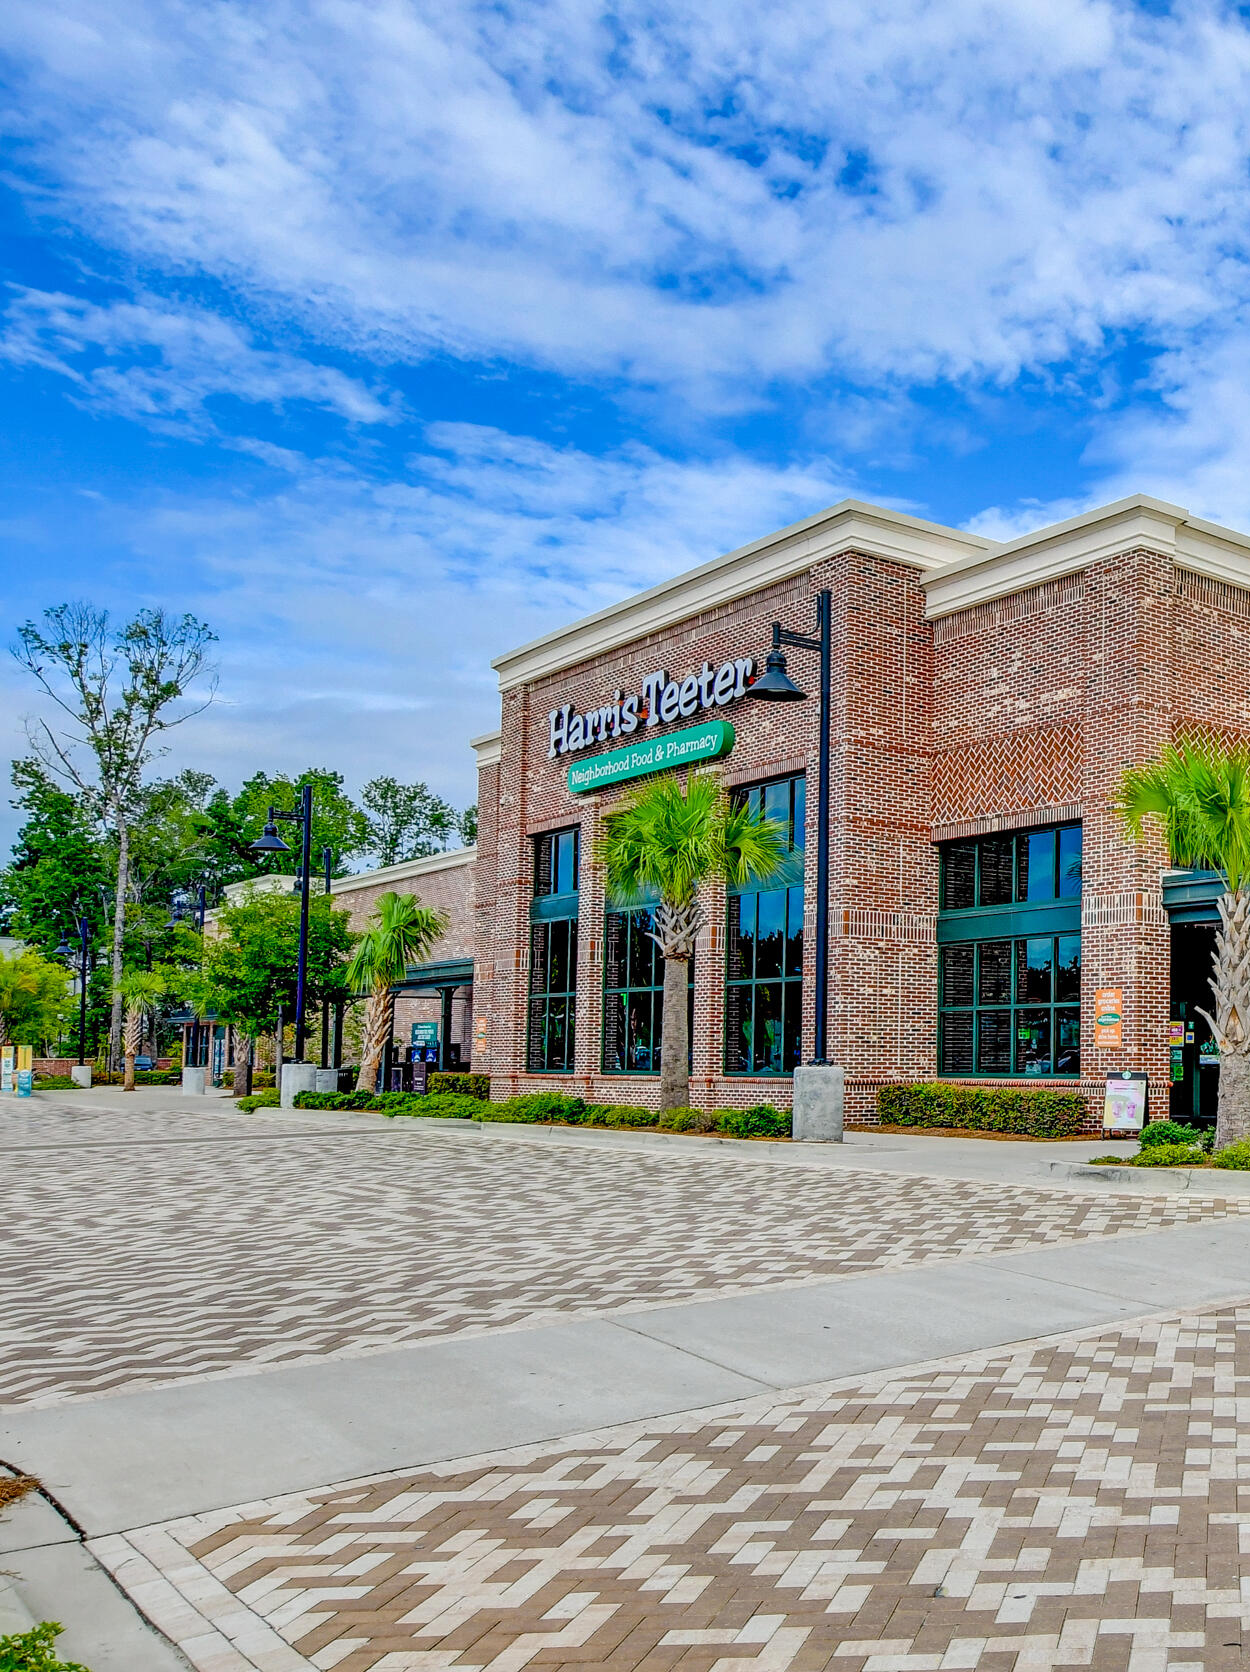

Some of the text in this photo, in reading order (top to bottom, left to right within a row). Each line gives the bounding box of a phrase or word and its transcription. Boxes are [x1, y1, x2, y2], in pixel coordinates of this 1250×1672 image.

[548, 657, 754, 759] Harris Teeter
[571, 734, 718, 786] Neighborhood Food & Pharmacy
